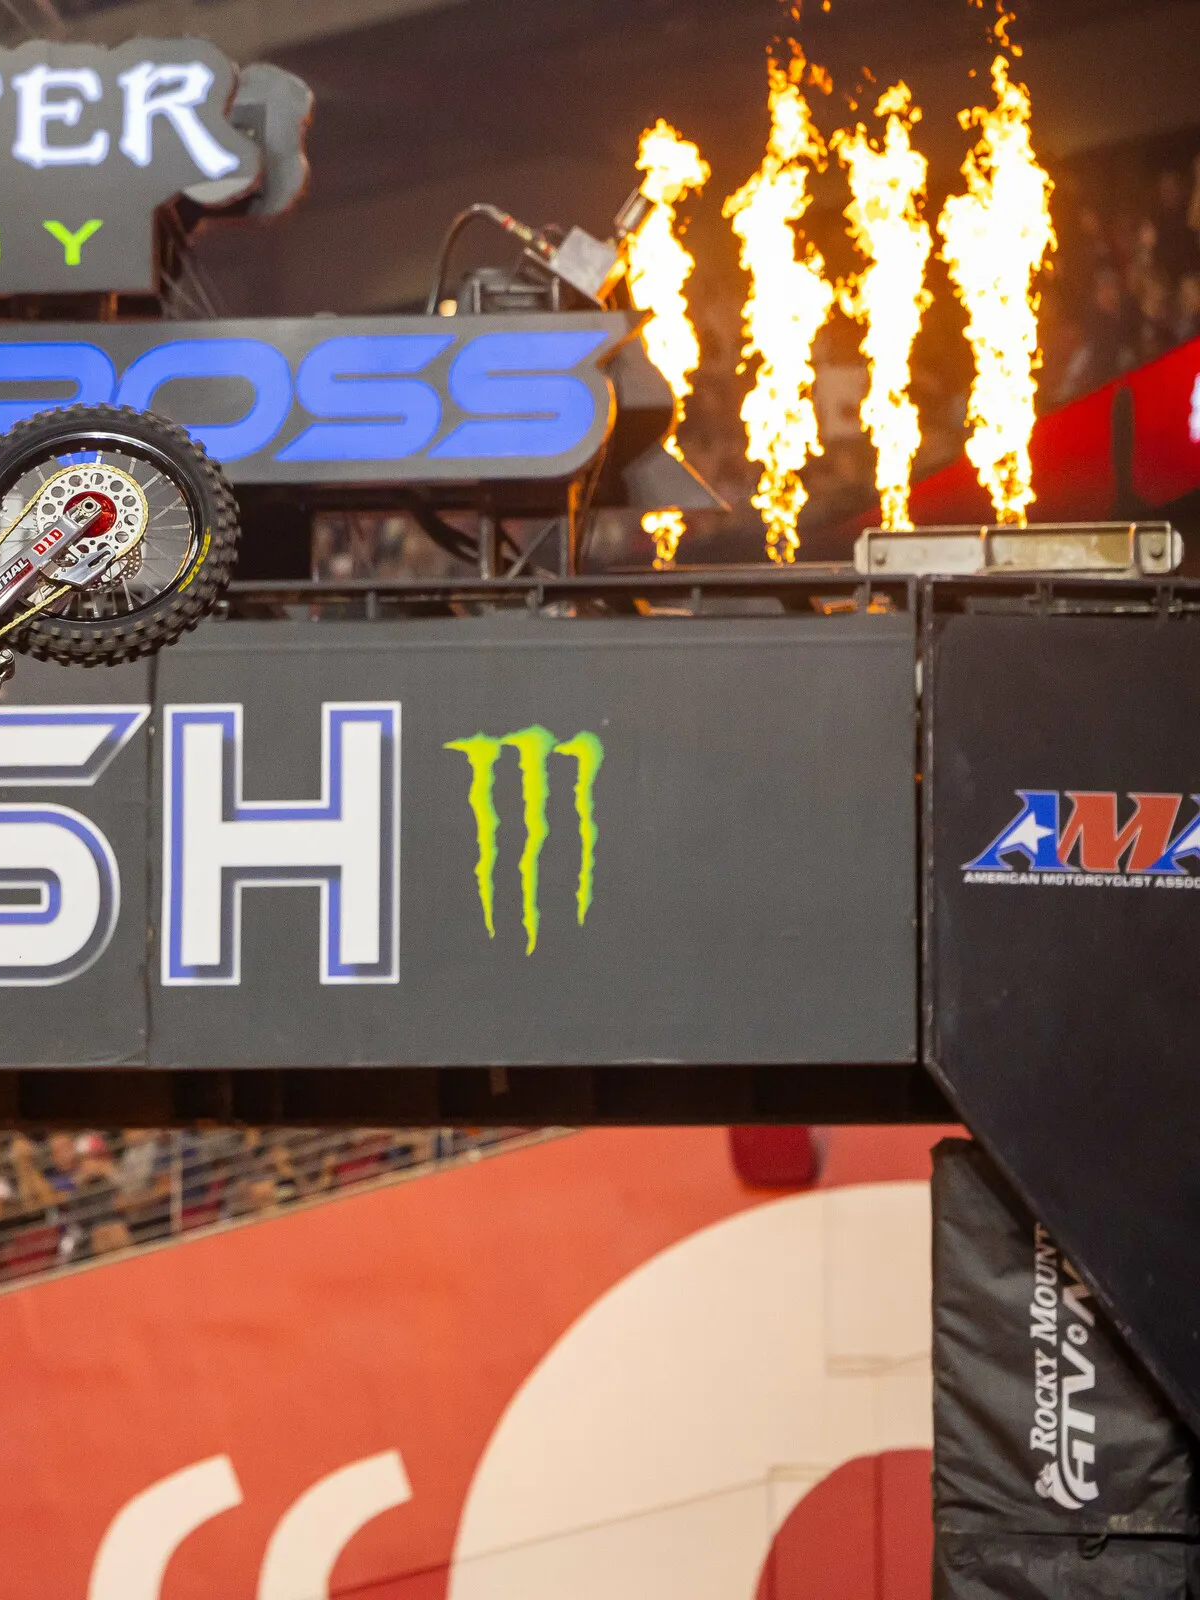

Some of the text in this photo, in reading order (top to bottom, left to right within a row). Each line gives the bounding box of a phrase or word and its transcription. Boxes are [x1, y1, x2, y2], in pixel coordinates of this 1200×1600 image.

[963, 870, 1040, 886] AMERICAN
[1041, 873, 1151, 888] MOTORCYCLIST
[1030, 1348, 1057, 1457] ROCKY
